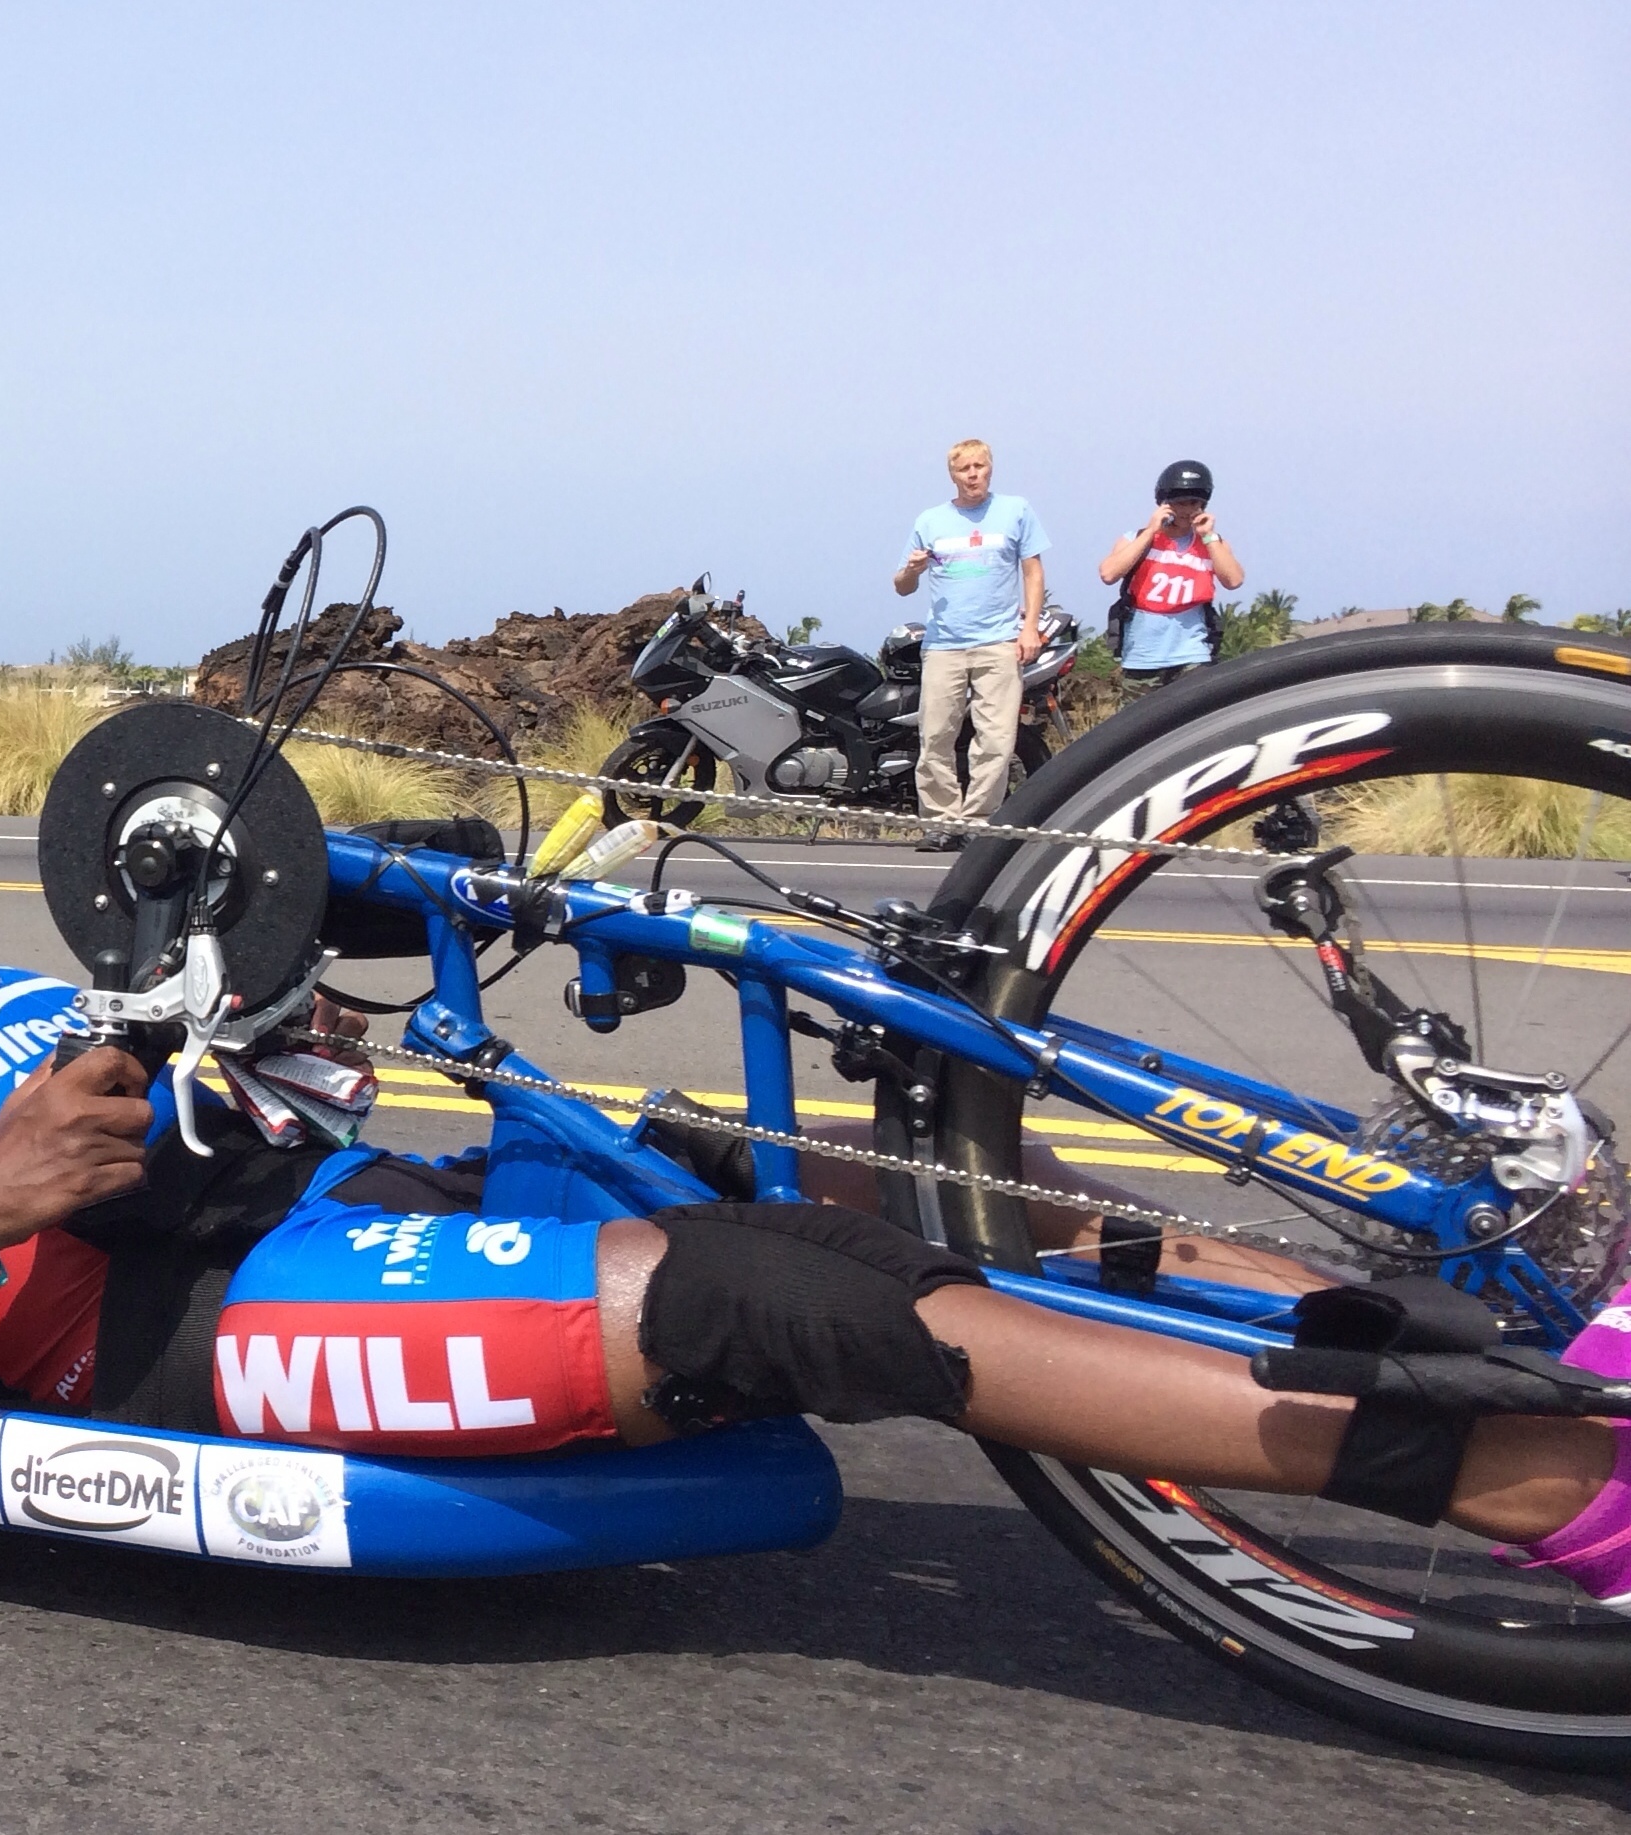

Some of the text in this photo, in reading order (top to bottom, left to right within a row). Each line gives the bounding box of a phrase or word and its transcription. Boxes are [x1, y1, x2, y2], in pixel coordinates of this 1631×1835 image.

[1146, 572, 1195, 605] 211
[690, 695, 749, 714] SUZUKI
[1018, 712, 1393, 972] ZIPP
[1269, 1132, 1411, 1192] END
[216, 1334, 537, 1434] WILL
[11, 1454, 185, 1516] directDME
[210, 1456, 281, 1496] CHALLENGED
[237, 1537, 321, 1558] FOUNDATION
